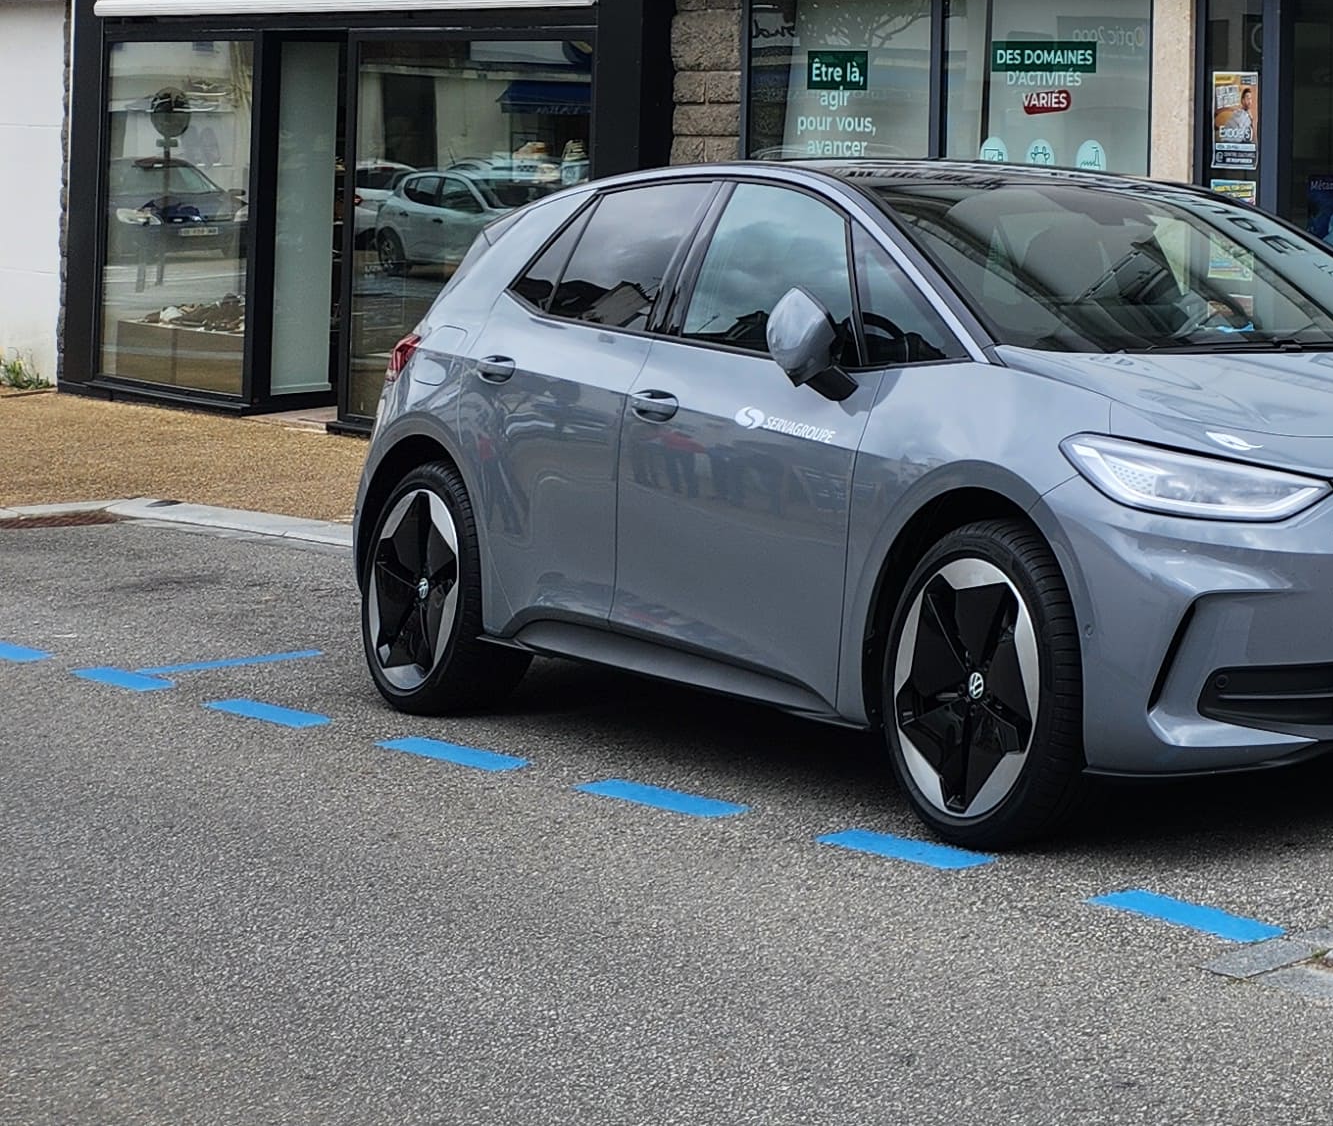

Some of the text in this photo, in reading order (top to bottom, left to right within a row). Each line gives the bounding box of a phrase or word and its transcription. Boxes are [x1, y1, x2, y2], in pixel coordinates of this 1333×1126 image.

[996, 50, 1094, 65] DES DOMAINES
[811, 58, 864, 85] Être là,
[1006, 68, 1082, 87] D'ACTIVITÉS
[820, 86, 851, 110] agir
[1022, 89, 1068, 108] VARIÉS
[797, 115, 877, 136] pour vous,
[807, 140, 868, 157] avancer
[763, 416, 837, 443] SERVAGROUPE
